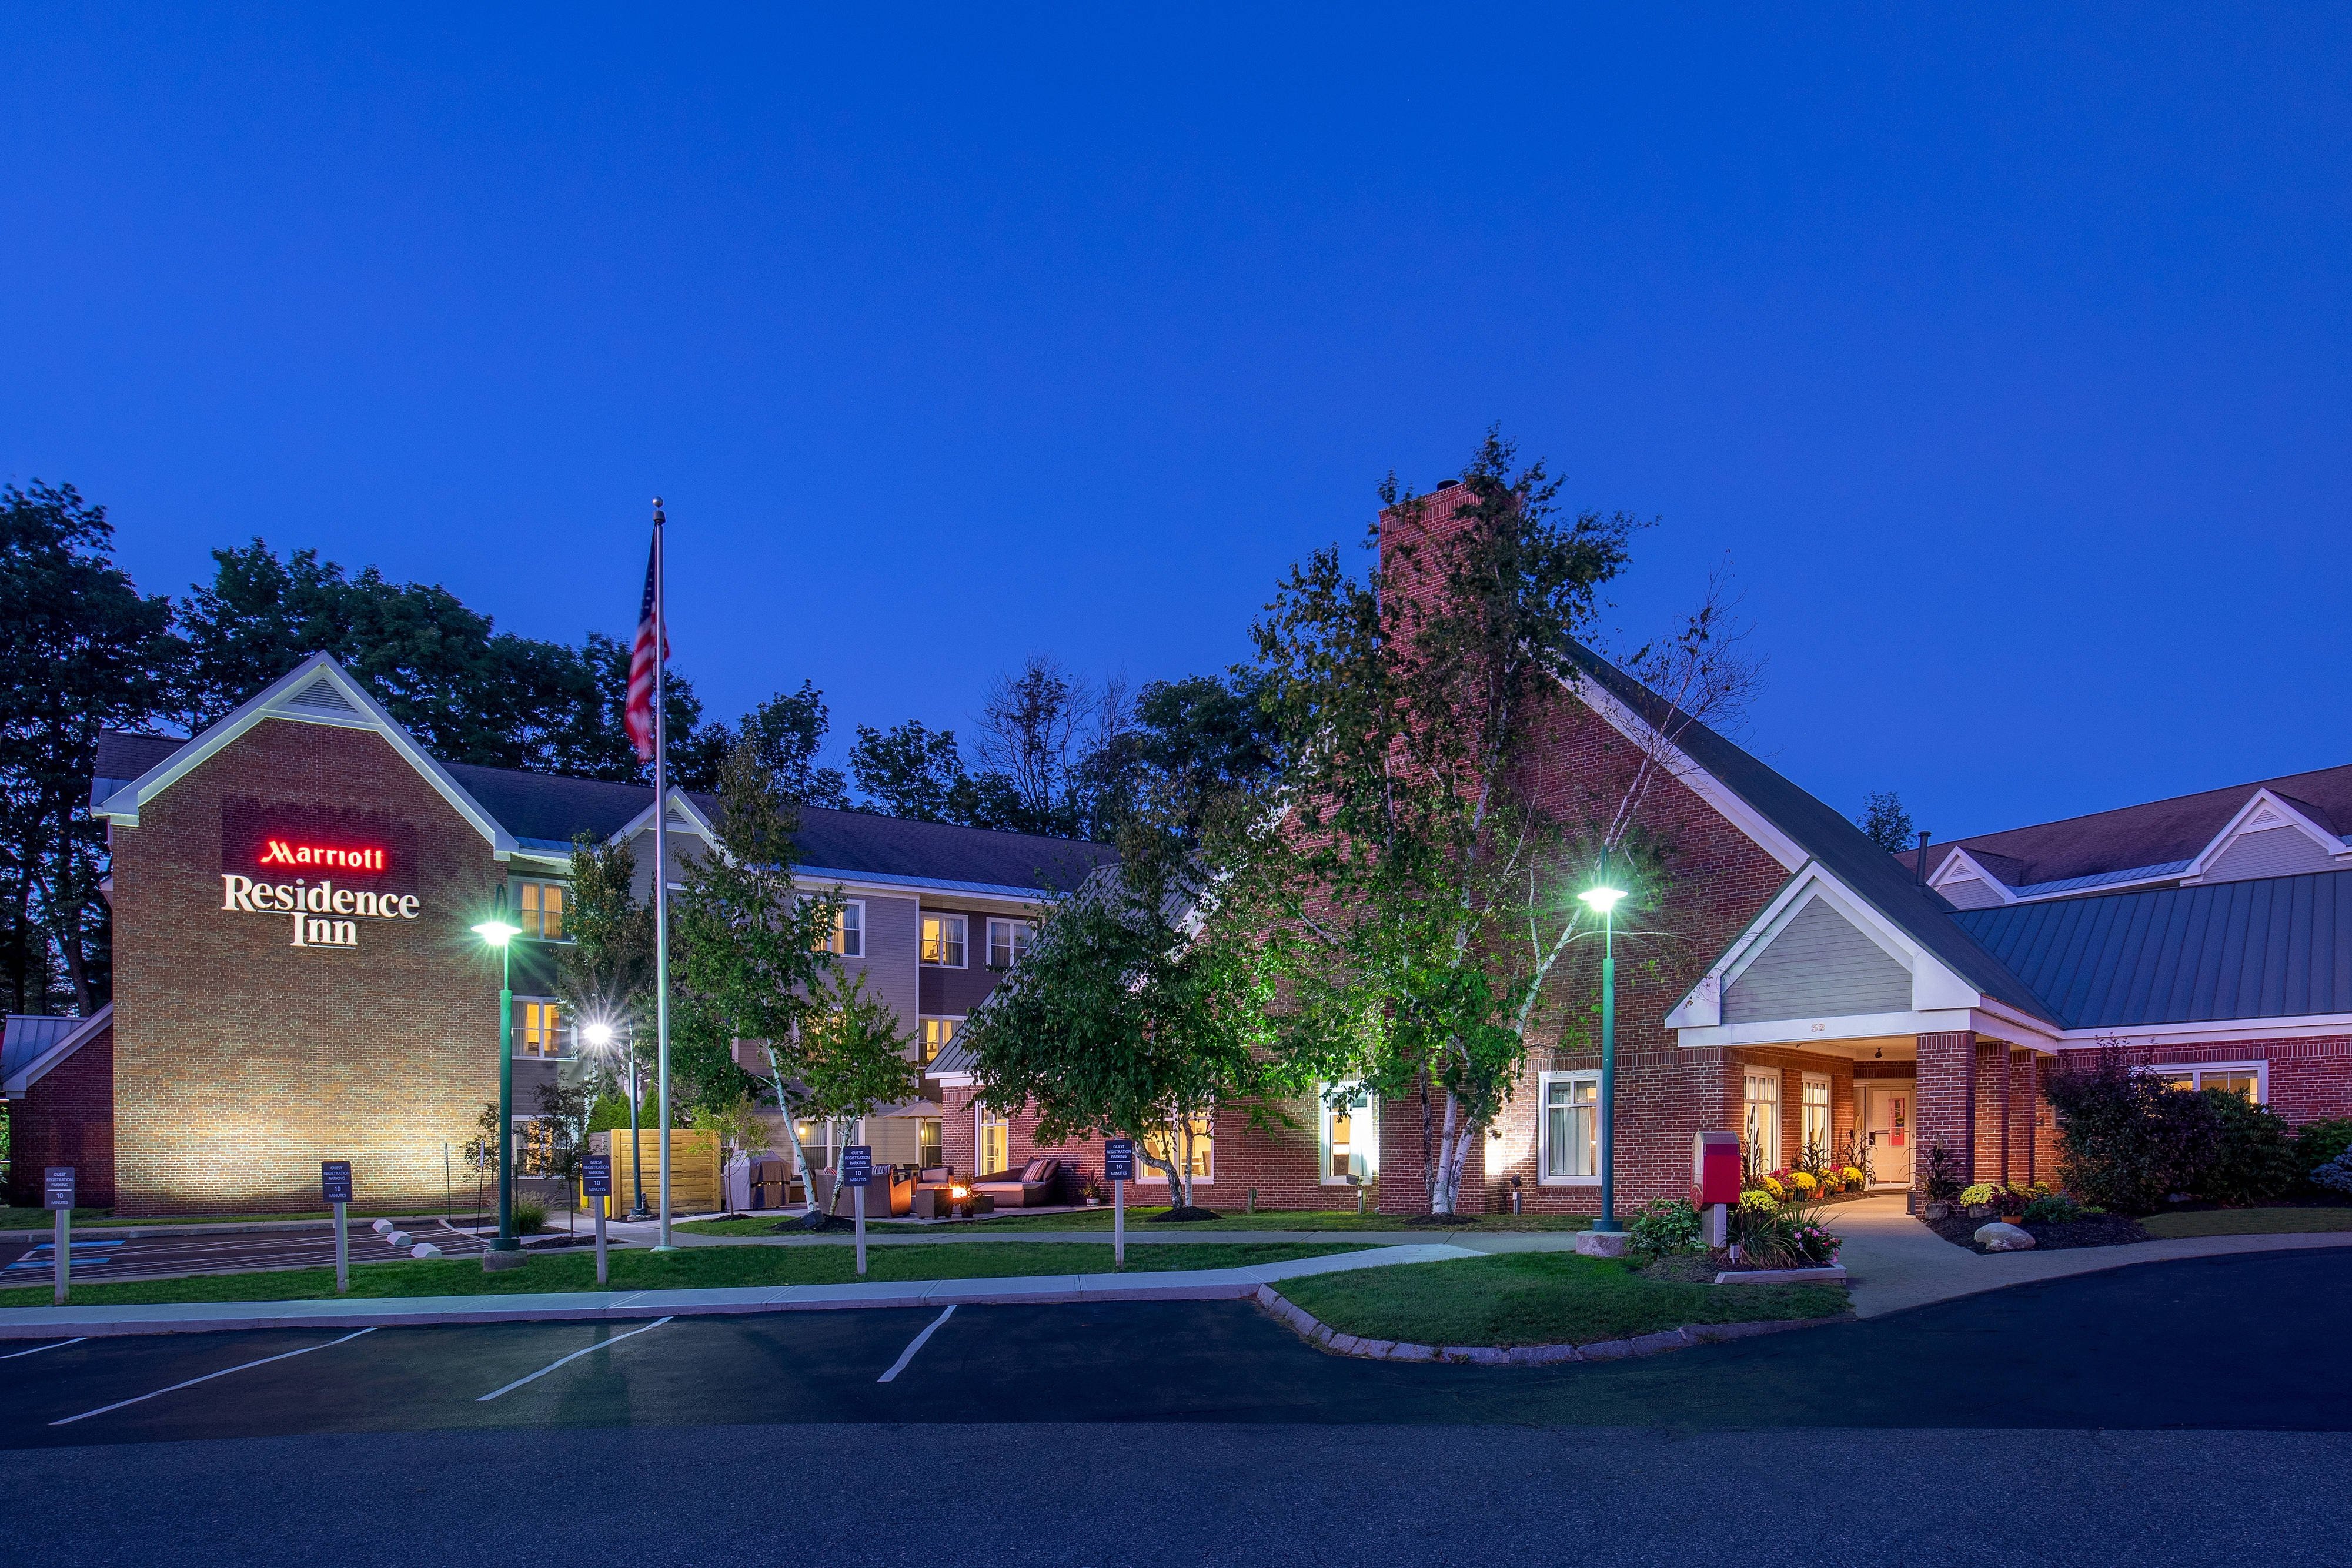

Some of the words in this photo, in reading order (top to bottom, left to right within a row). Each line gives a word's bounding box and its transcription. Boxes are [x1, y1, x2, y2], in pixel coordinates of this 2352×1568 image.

[260, 840, 383, 870] Marriott
[220, 873, 420, 919] Residence
[290, 911, 358, 947] Inn
